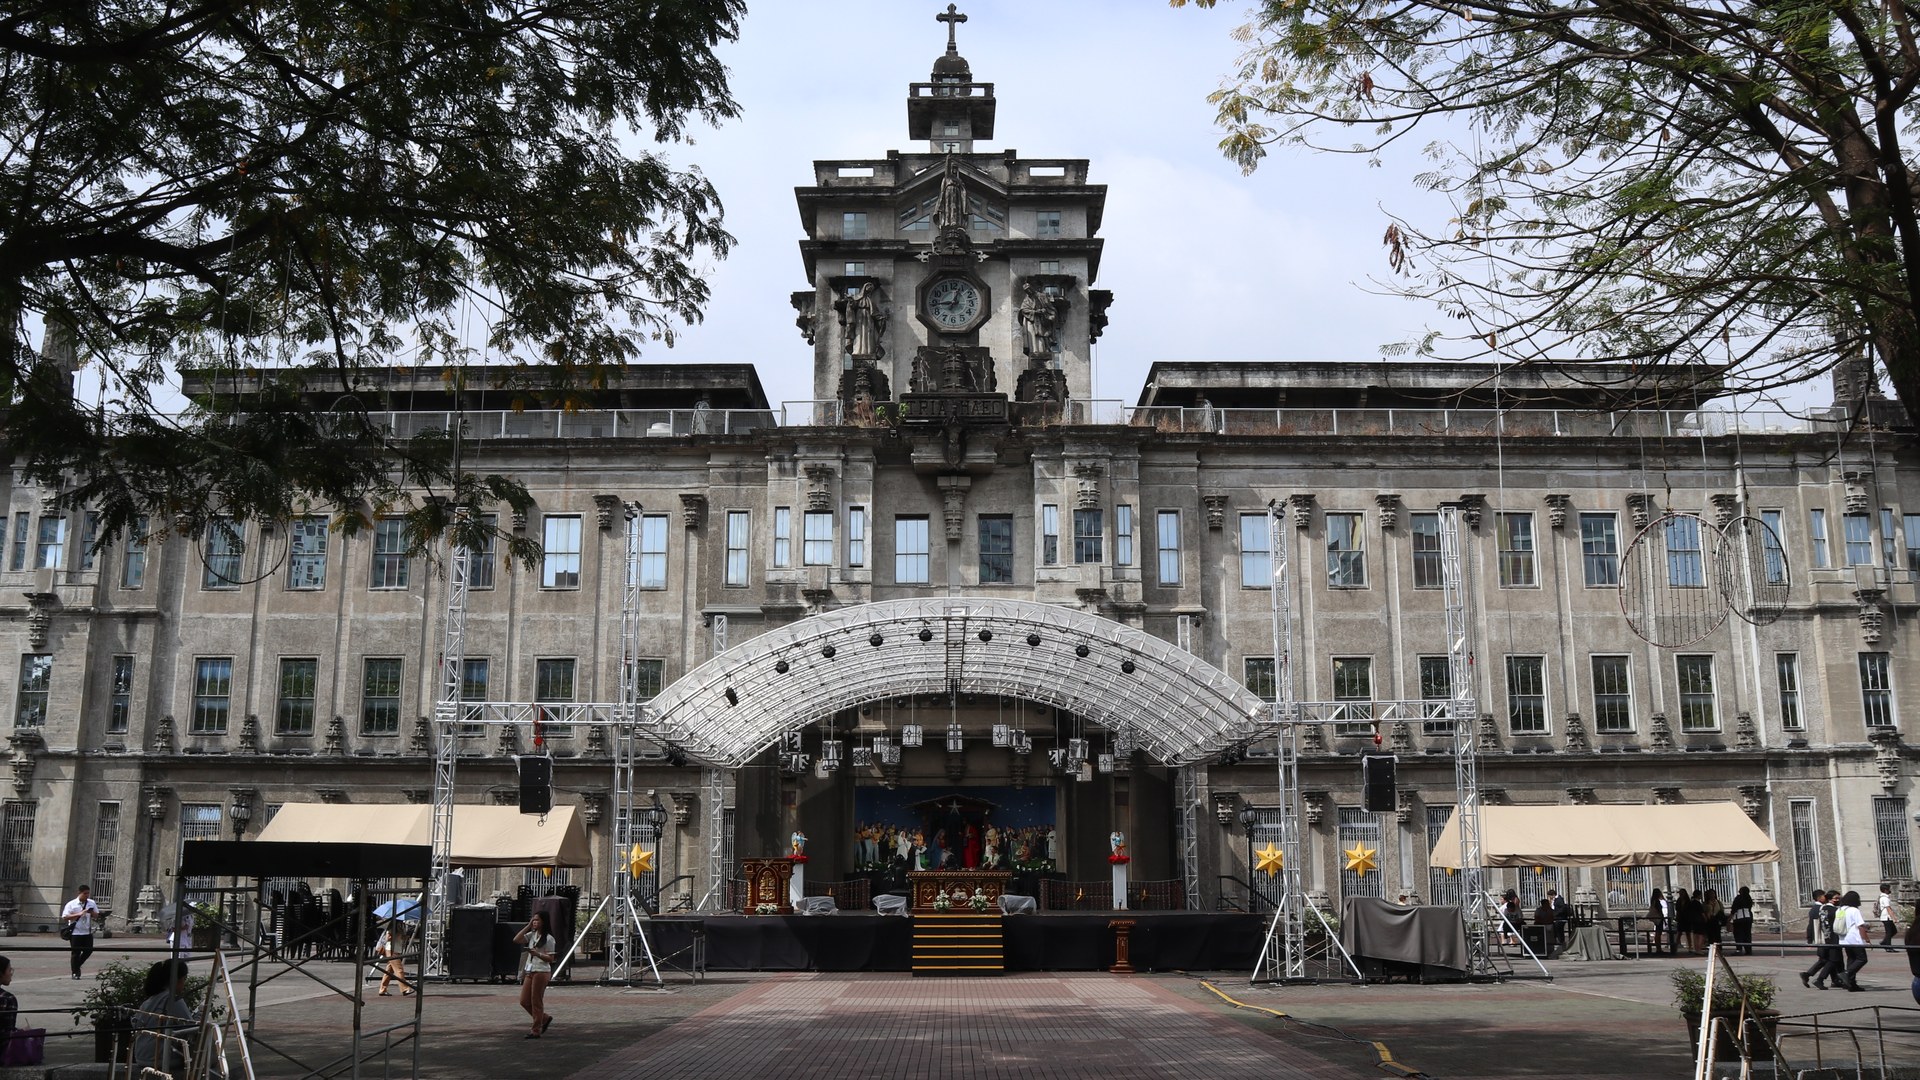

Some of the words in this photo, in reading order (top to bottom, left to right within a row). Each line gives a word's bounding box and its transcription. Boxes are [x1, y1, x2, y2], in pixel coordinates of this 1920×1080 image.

[950, 282, 957, 290] 12
[934, 290, 942, 298] 10
[967, 290, 973, 298] 2
[934, 308, 940, 316] 8
[907, 400, 947, 415] TRIA
[960, 400, 1002, 415] HAEC
